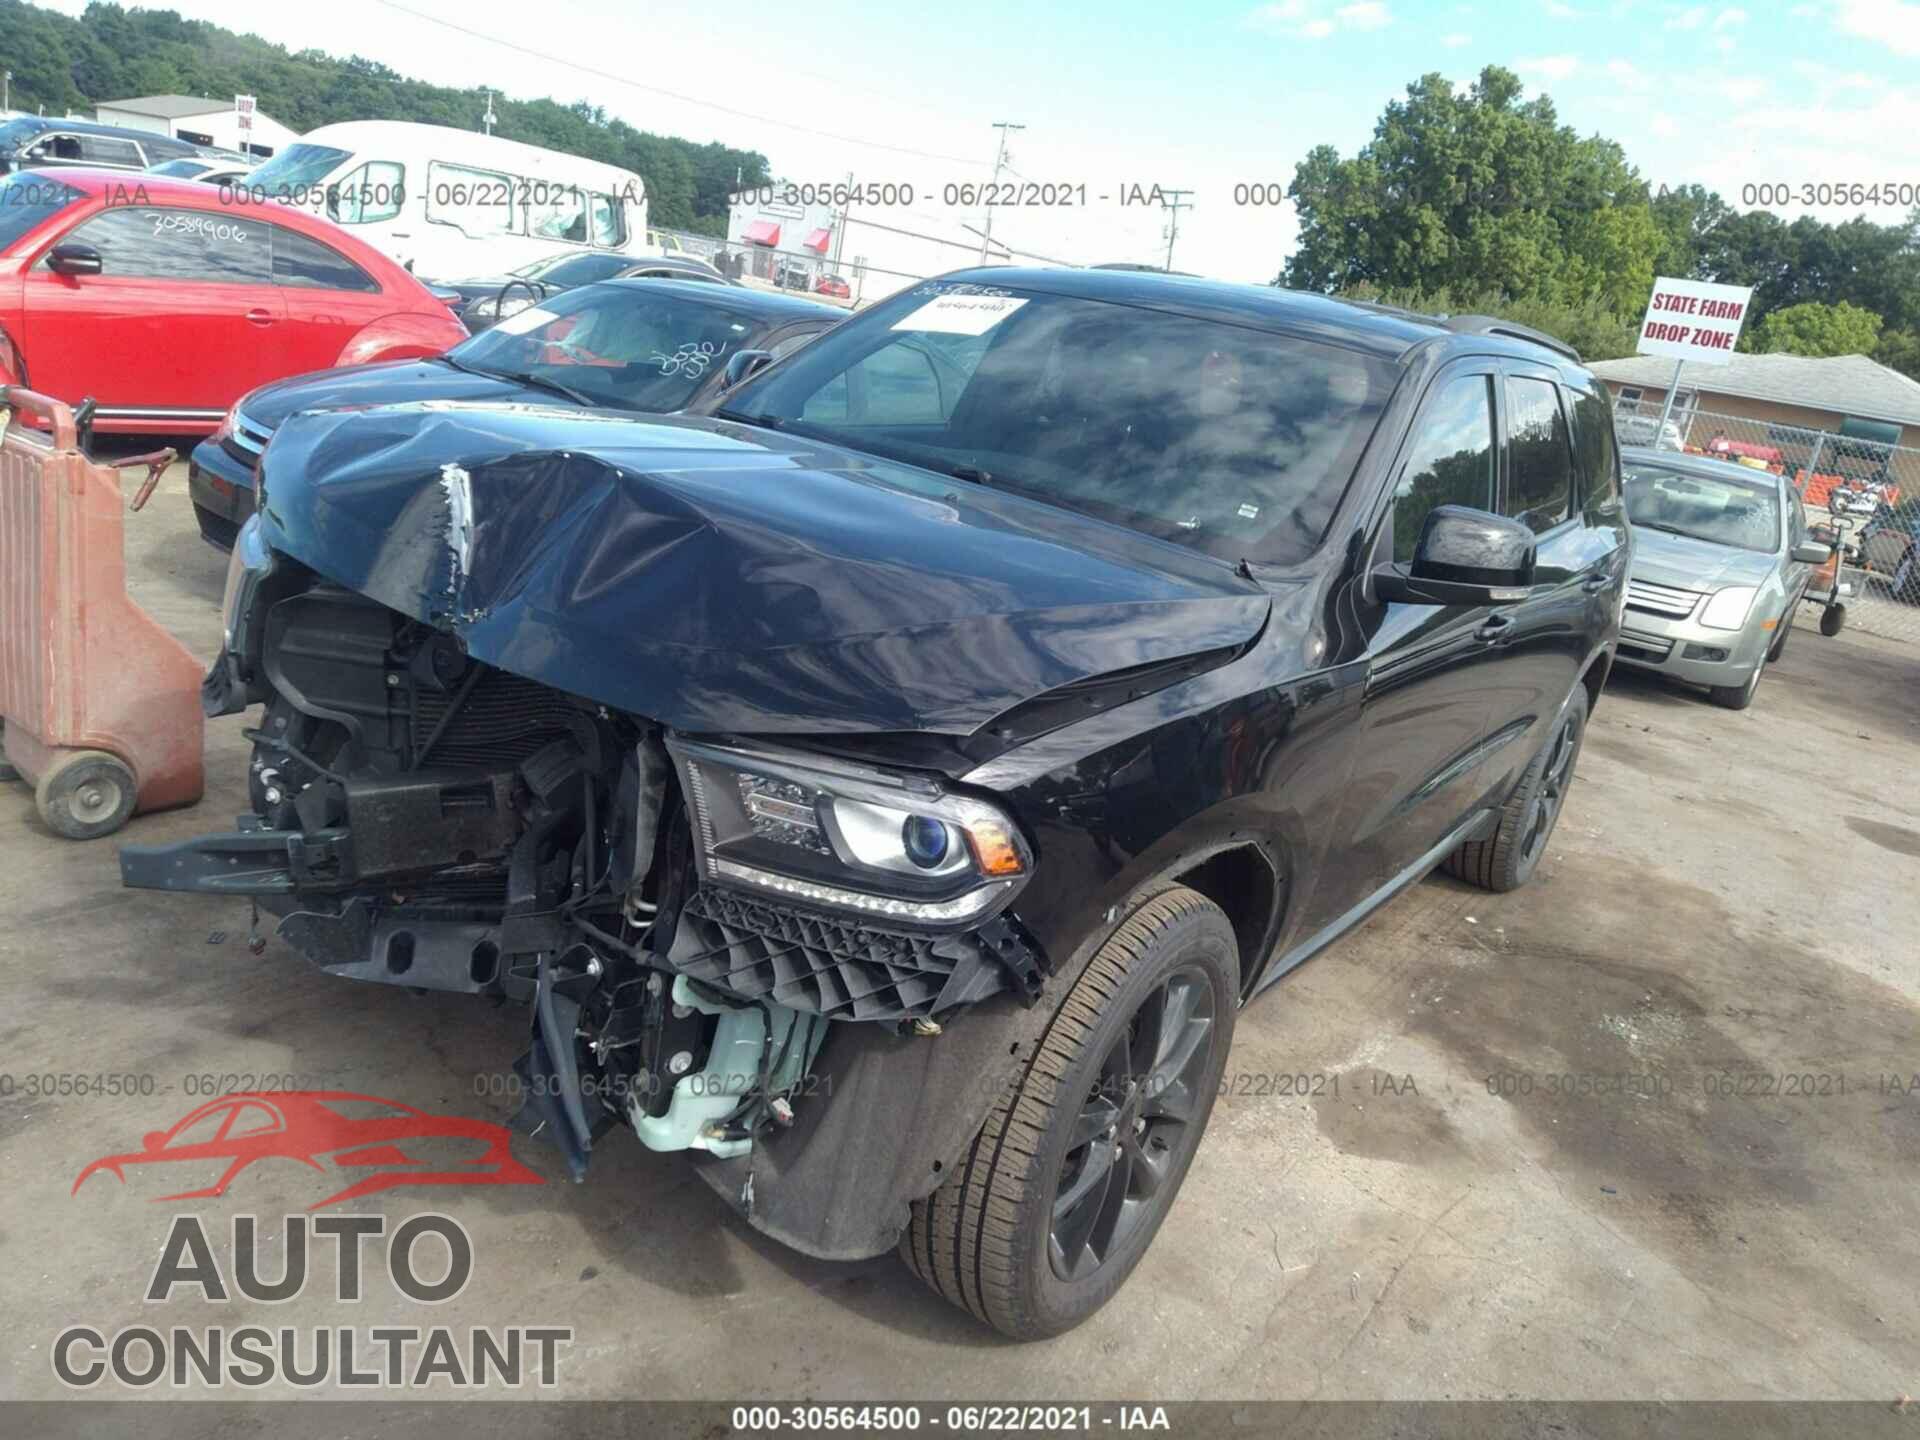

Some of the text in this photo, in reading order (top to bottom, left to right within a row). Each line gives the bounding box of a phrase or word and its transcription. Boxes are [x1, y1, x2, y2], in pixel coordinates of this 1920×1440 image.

[1652, 292, 1744, 321] STATE FARM
[1644, 321, 1734, 350] DROP ZONE
